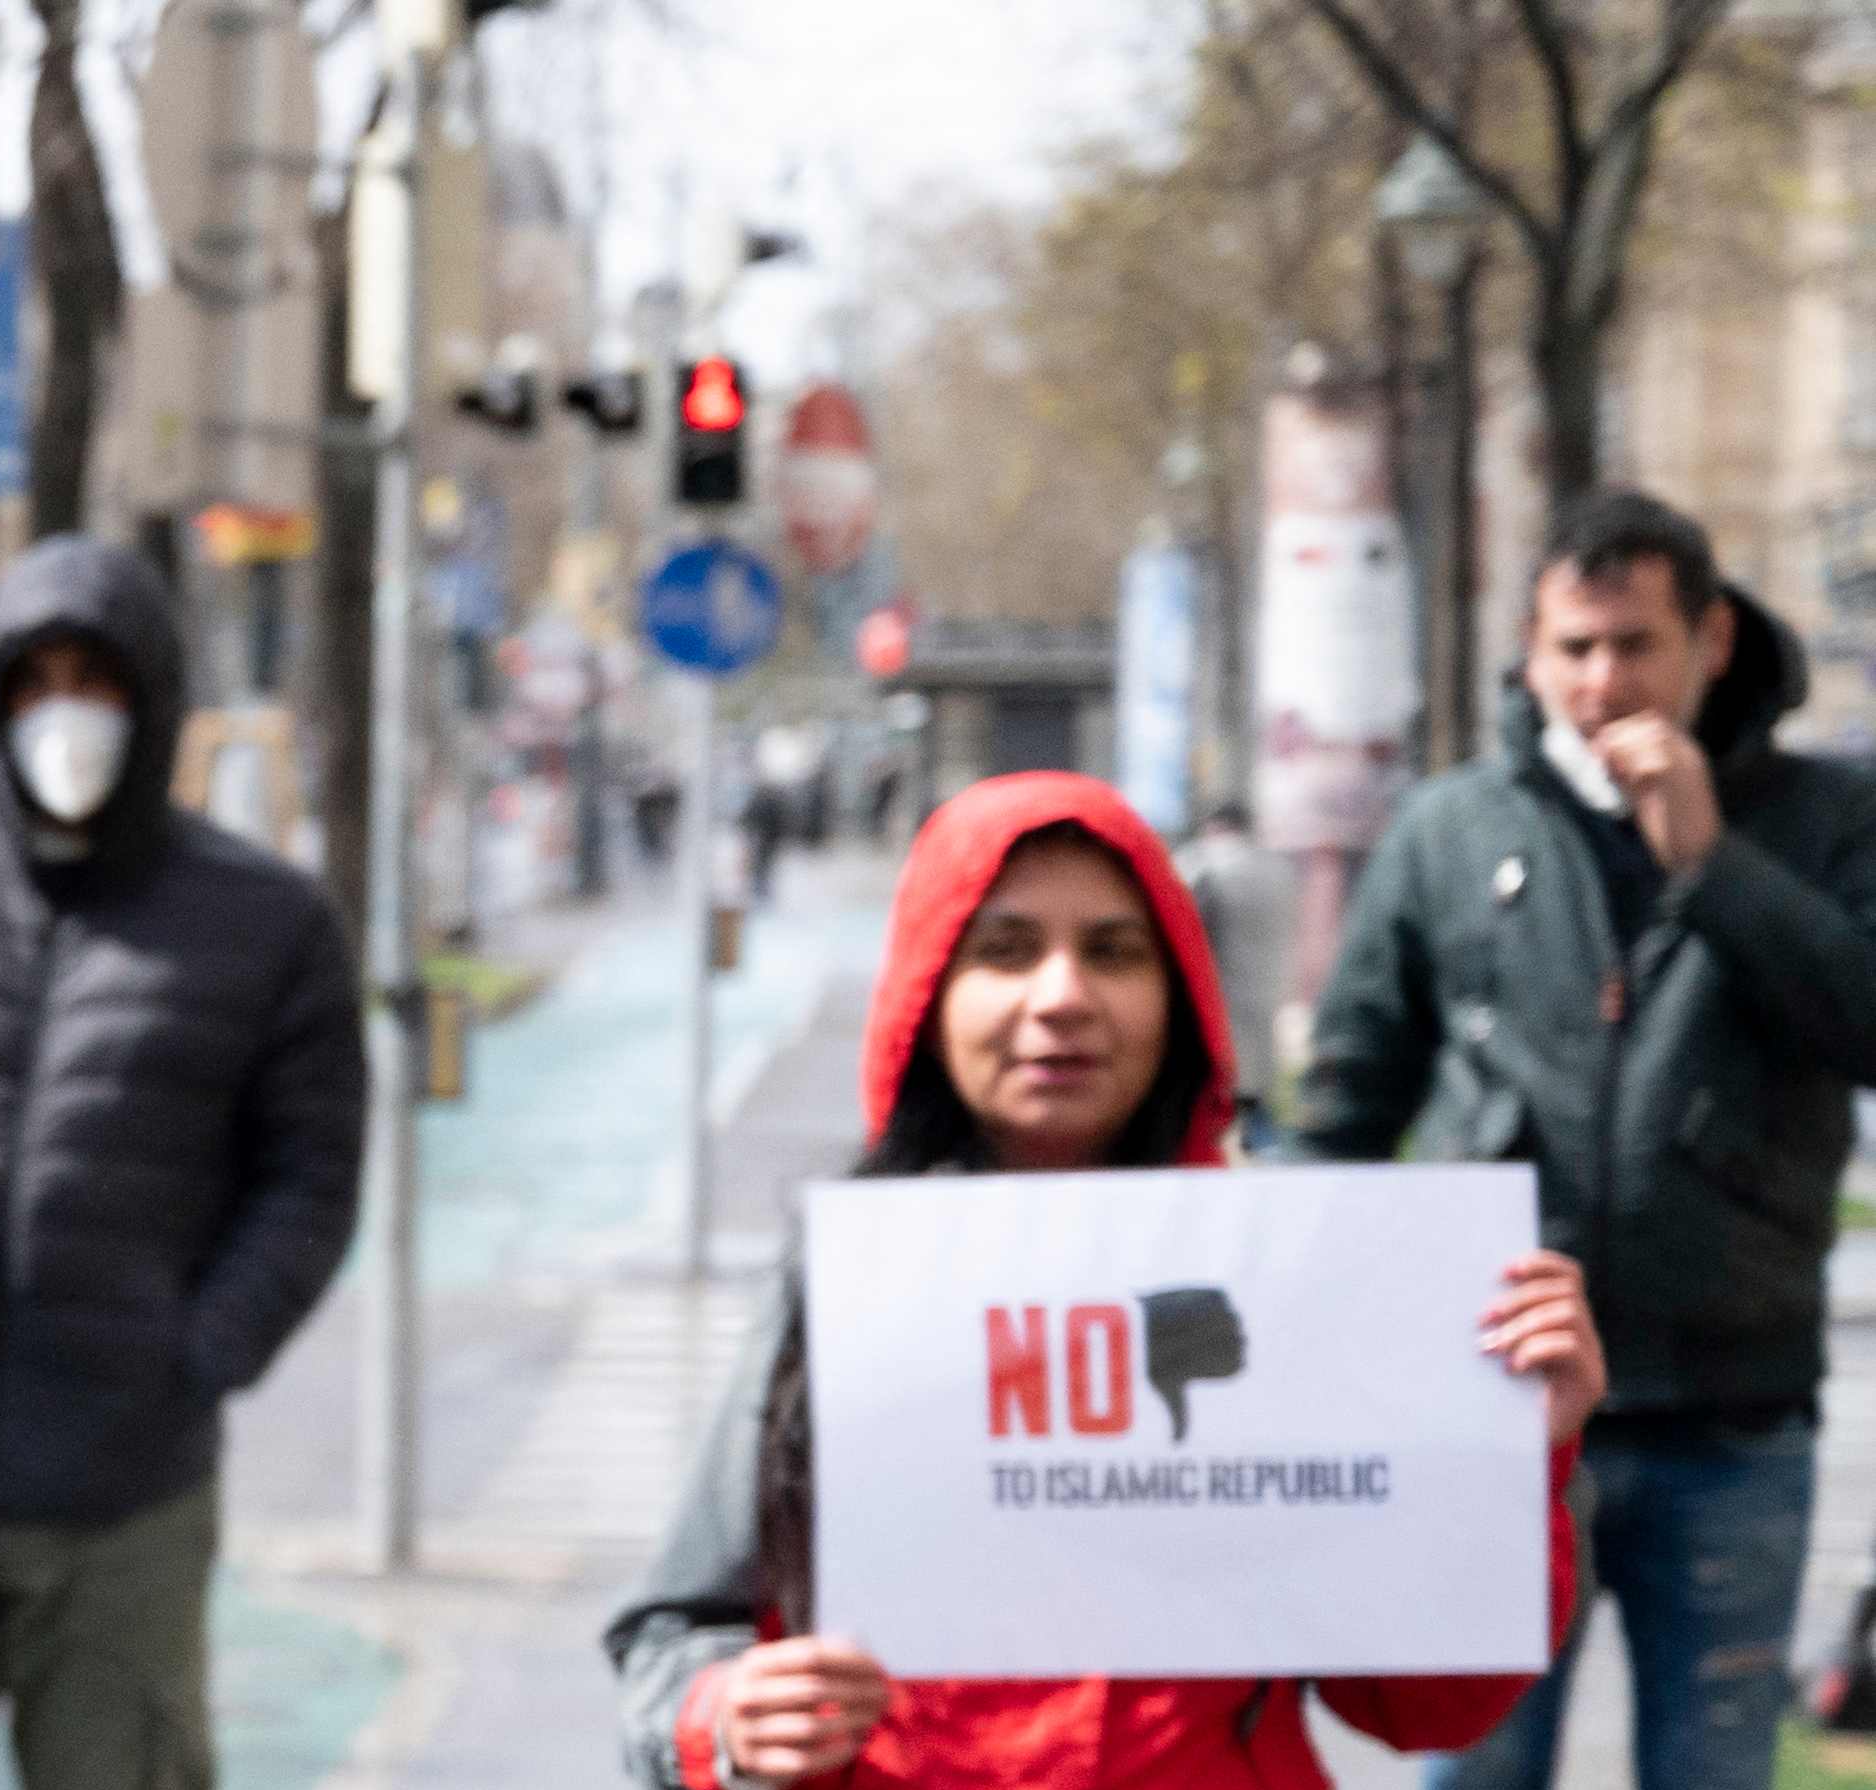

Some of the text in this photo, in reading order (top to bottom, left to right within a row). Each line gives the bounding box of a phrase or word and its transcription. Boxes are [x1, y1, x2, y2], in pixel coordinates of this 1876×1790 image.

[986, 1304, 1133, 1437] NO
[990, 1457, 1391, 1510] TO ISLAMIC REPUBLIC
